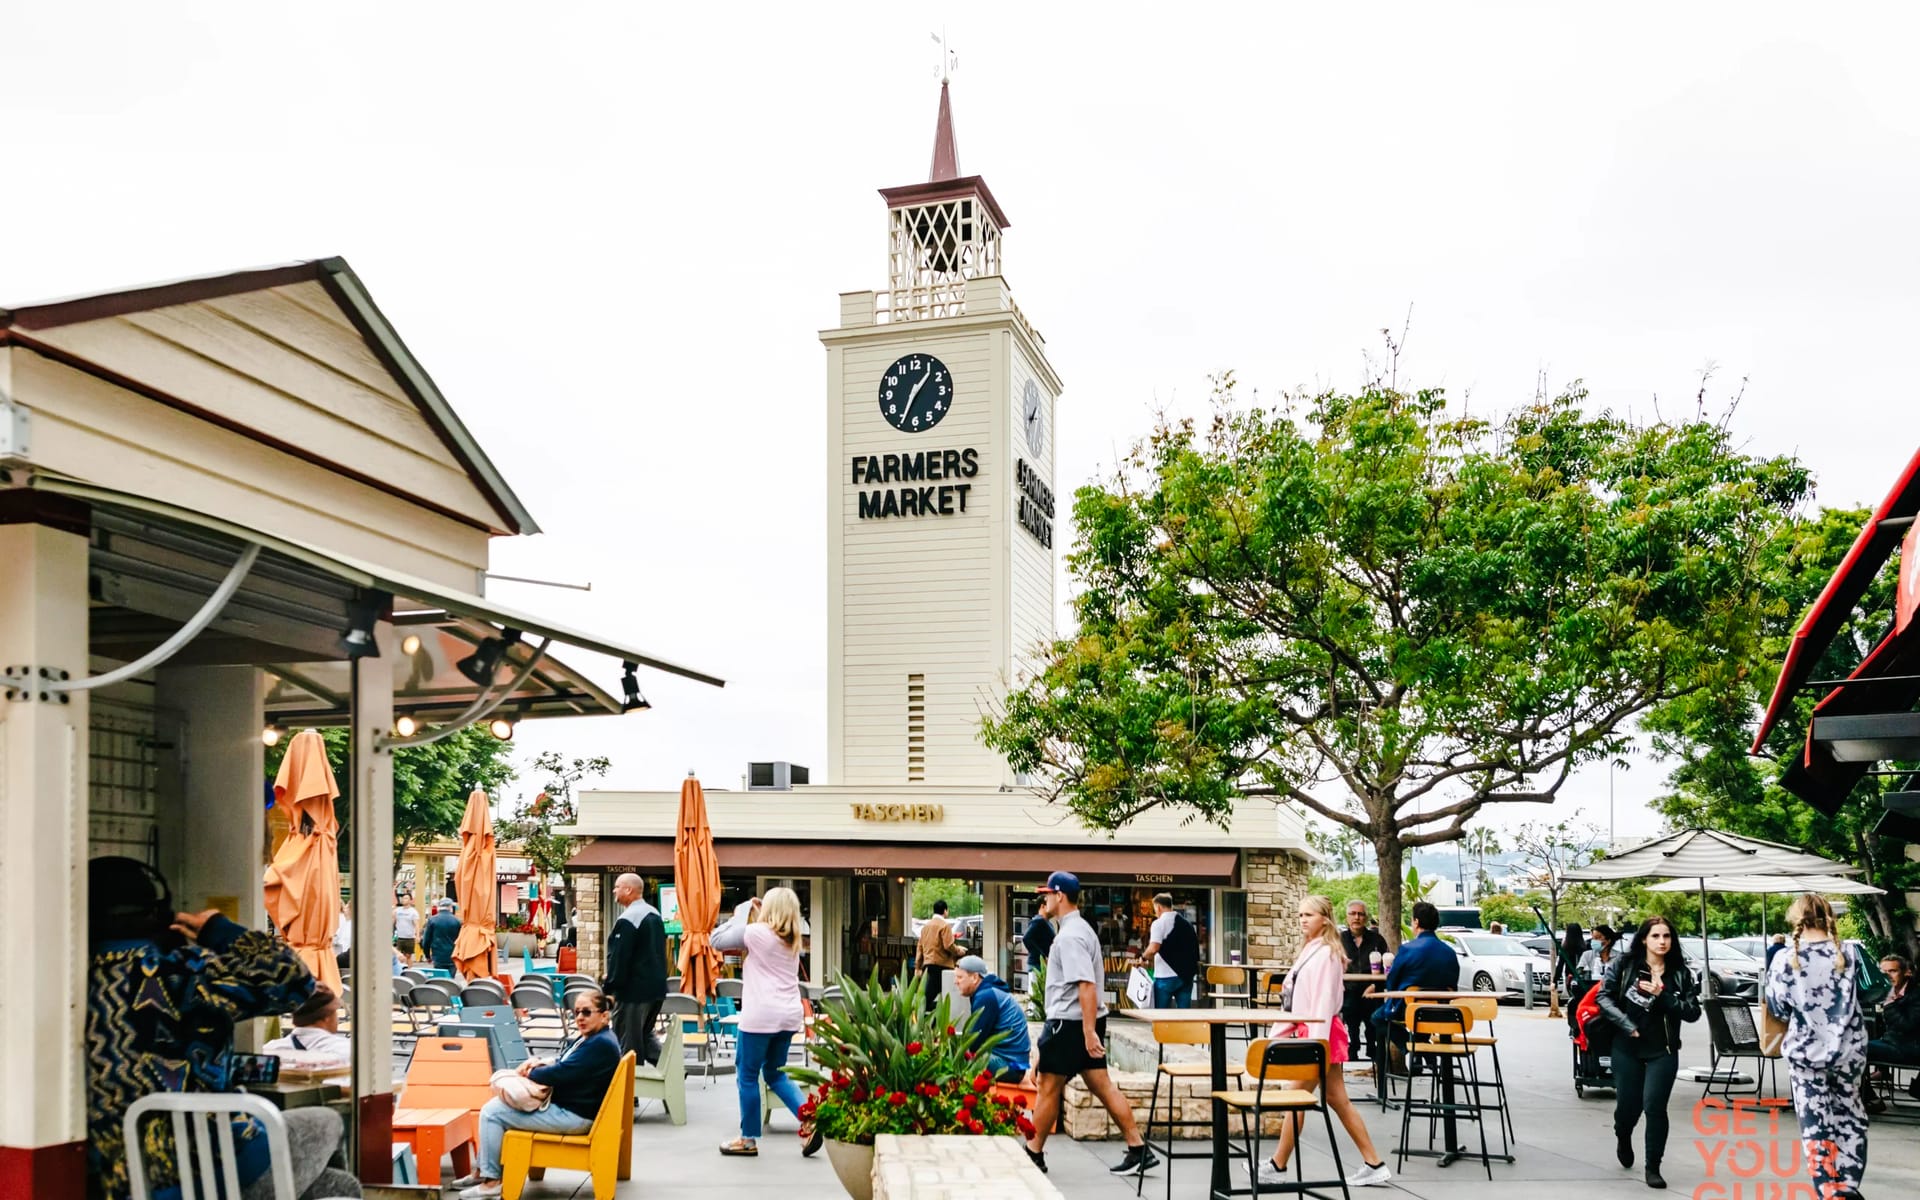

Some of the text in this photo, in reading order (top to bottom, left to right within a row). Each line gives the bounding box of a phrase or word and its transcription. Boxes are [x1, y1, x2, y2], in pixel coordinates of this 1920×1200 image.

[898, 364, 907, 375] 11
[910, 359, 921, 371] 12
[888, 375, 898, 387] 10
[935, 371, 943, 382] 2
[885, 389, 893, 401] 9
[938, 385, 946, 396] 3
[889, 403, 897, 414] 8
[934, 400, 942, 411] 4
[911, 415, 919, 426] 6
[925, 411, 933, 421] 5
[852, 448, 979, 485] FARMERS
[858, 484, 972, 519] MARKET
[850, 803, 944, 823] TASCHEN
[606, 865, 637, 874] TASCHEN
[853, 867, 888, 877] TASCHEN
[1135, 873, 1174, 884] TASCHEN
